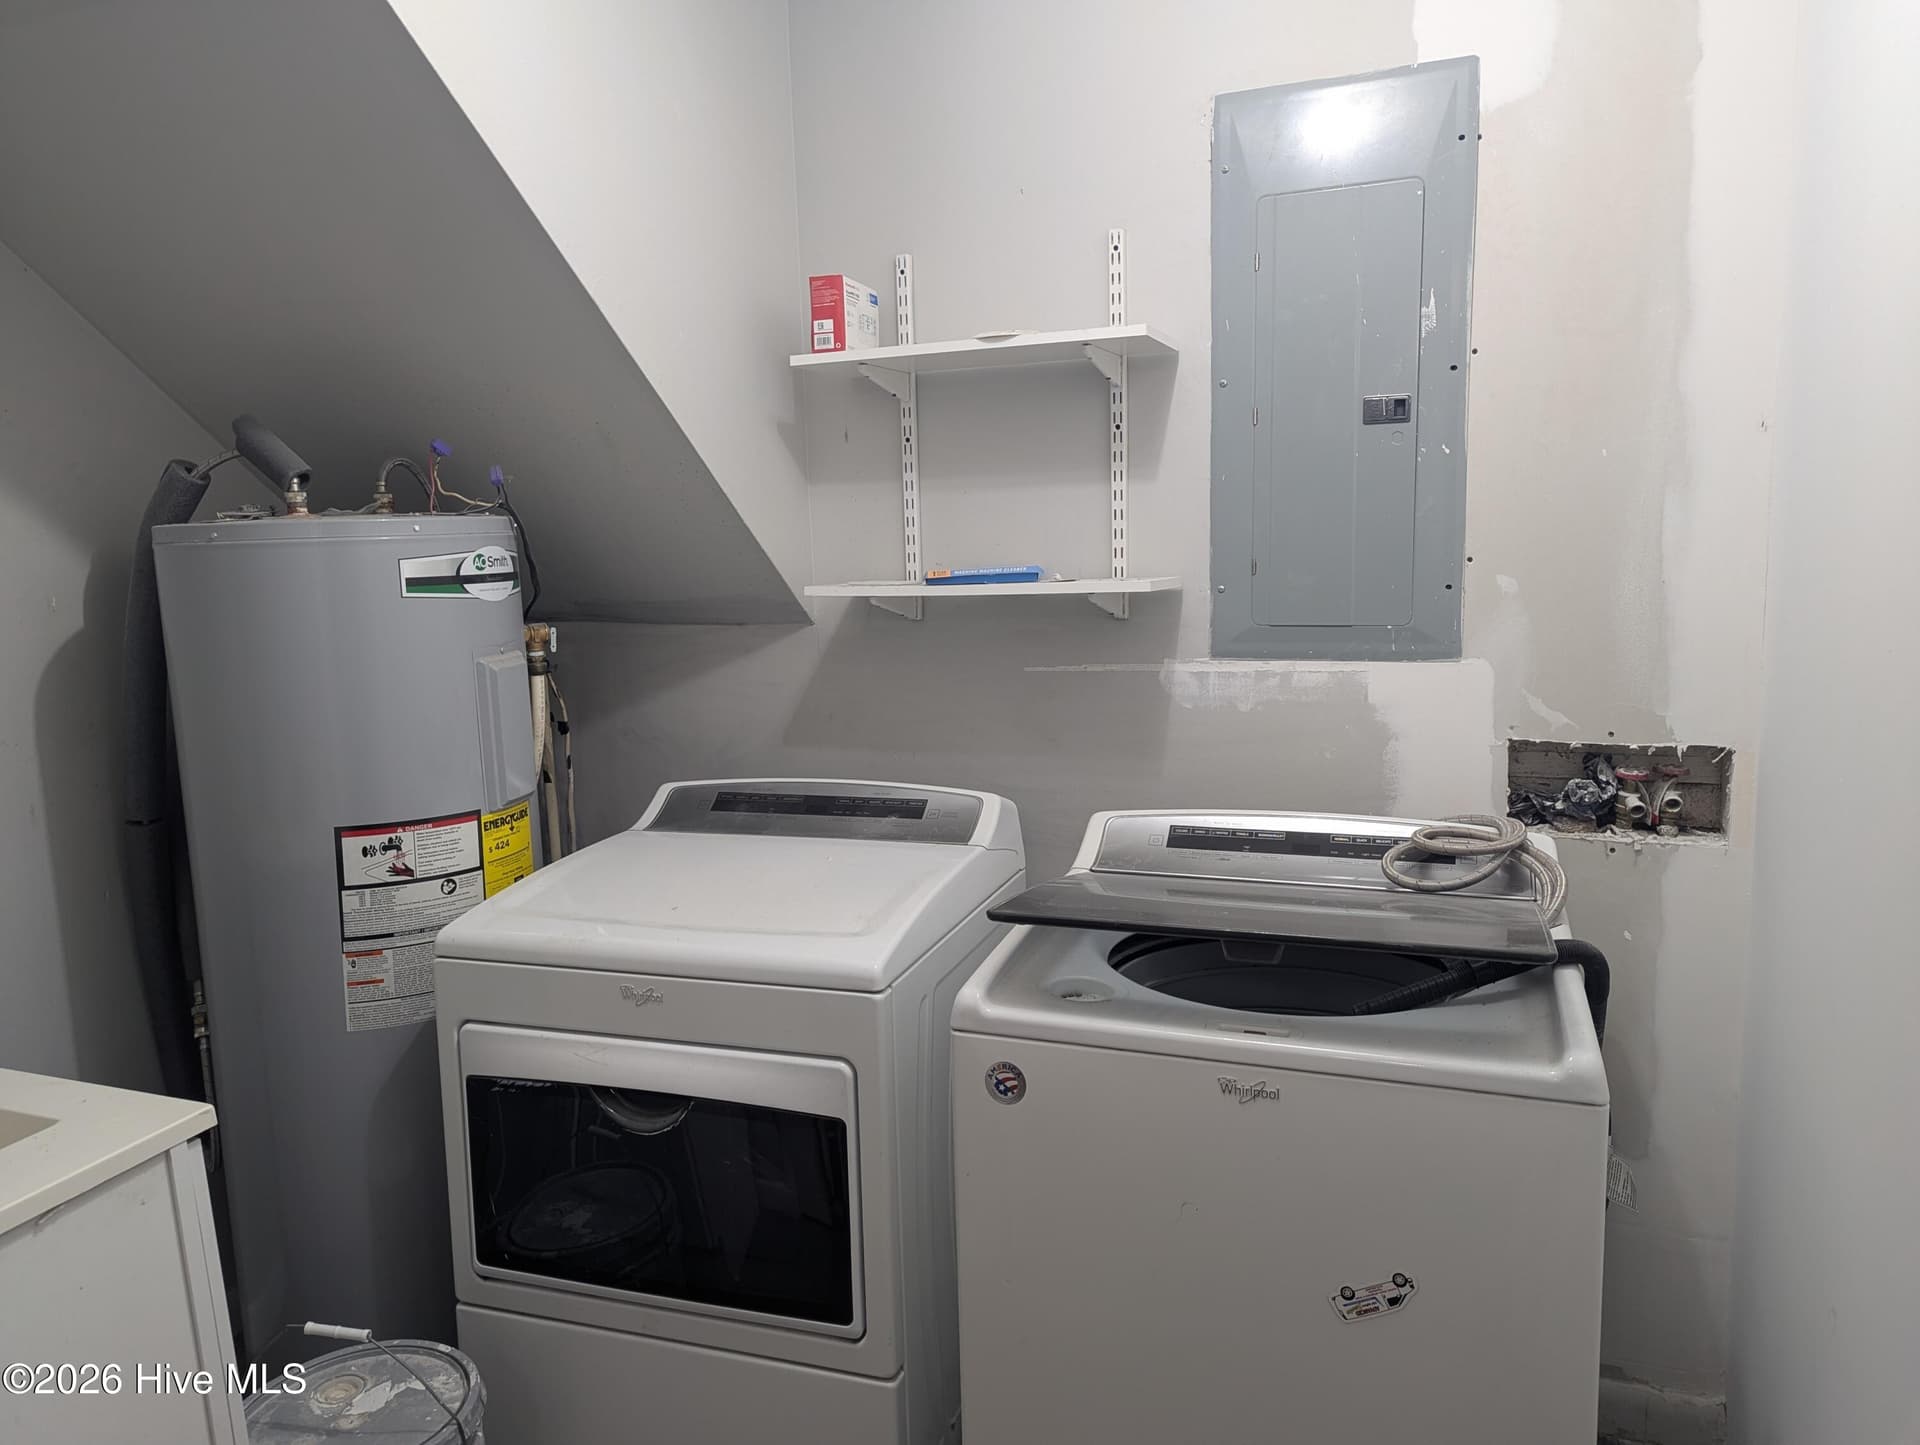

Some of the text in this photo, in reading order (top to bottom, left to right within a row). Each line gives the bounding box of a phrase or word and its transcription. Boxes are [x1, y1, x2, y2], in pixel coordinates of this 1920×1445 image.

[487, 555, 509, 568] Smith
[405, 823, 433, 832] DANGER
[495, 839, 510, 851] 424
[1217, 1077, 1280, 1104] Whirlpool
